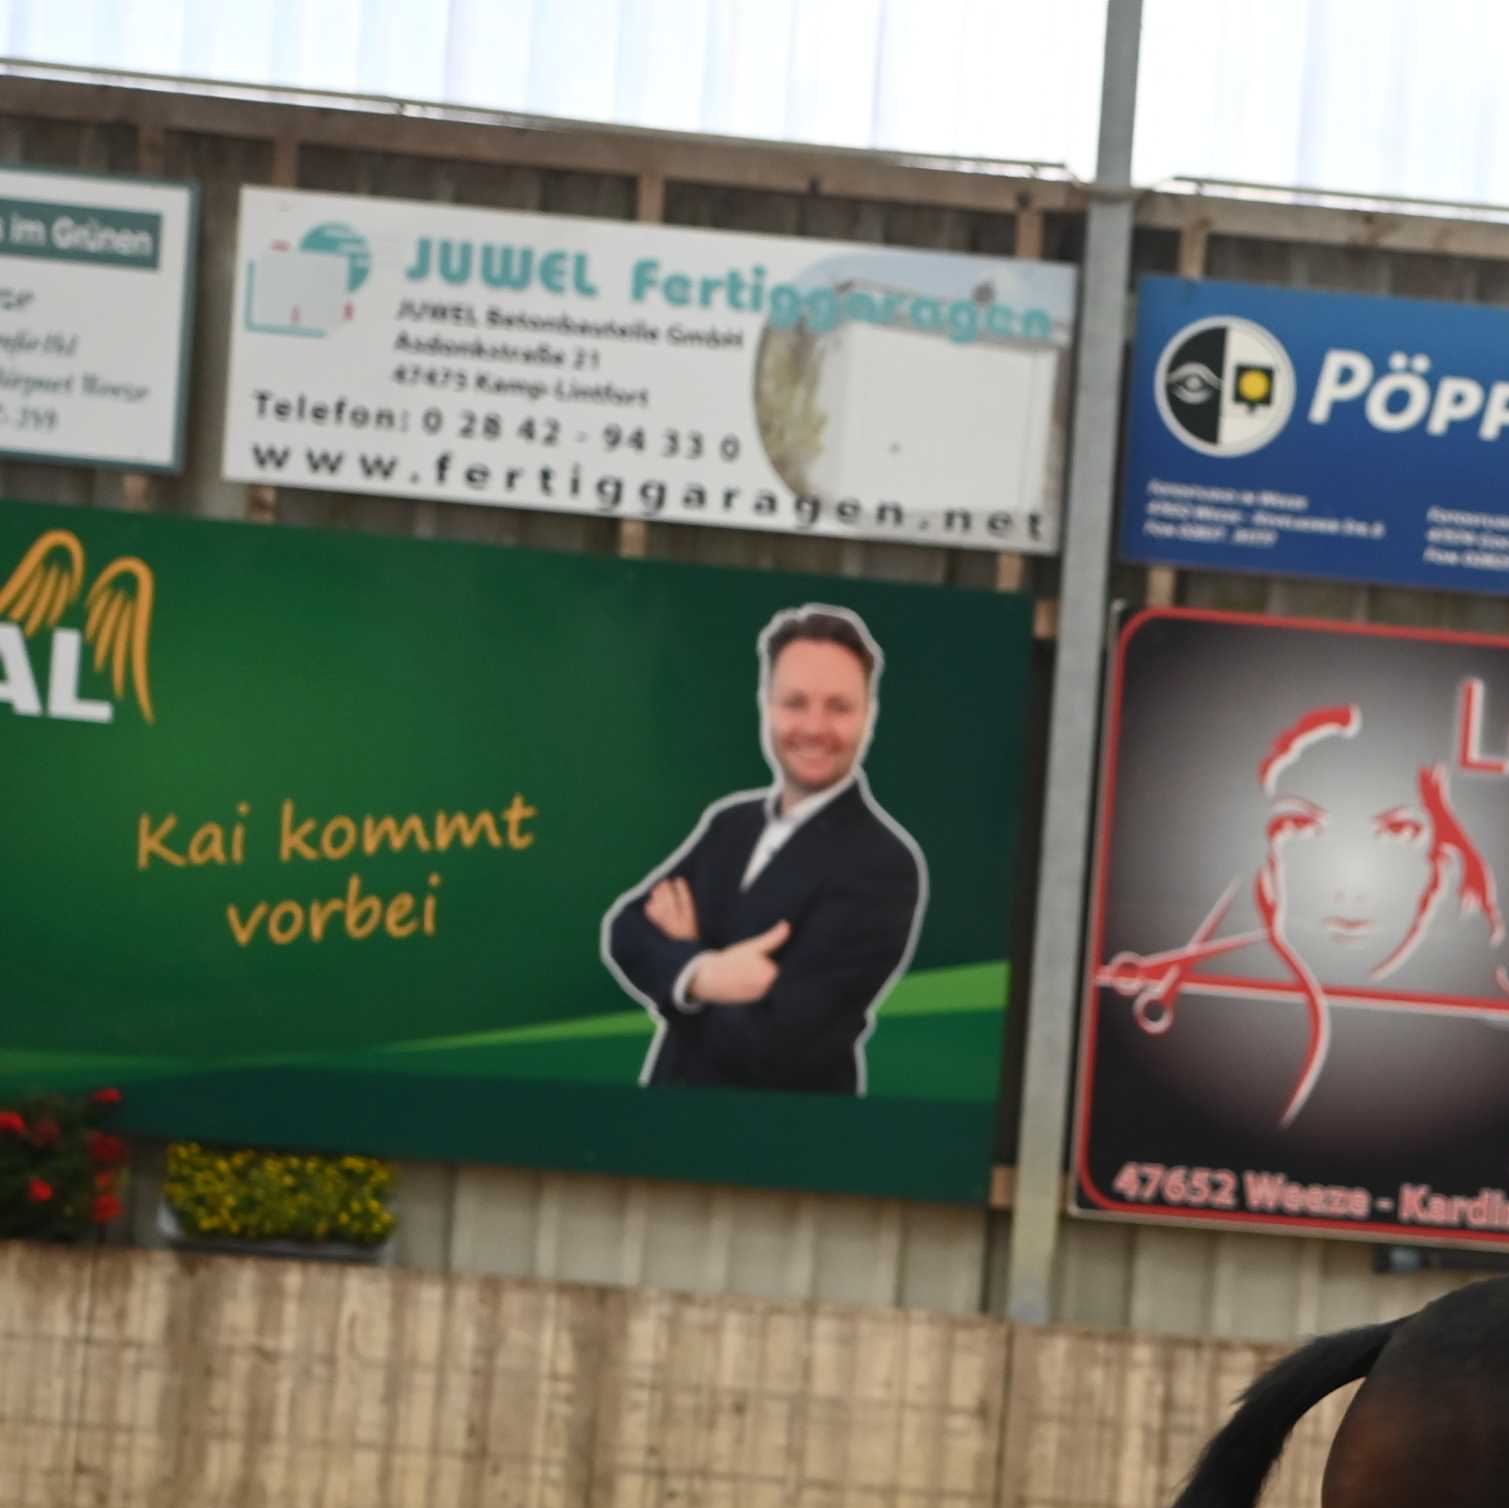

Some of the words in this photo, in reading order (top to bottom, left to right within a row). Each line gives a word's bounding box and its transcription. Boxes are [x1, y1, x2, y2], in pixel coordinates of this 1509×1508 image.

[405, 237, 599, 297] JUWEL
[253, 389, 411, 434] Telefon:
[252, 443, 1044, 542] www.fertiggaragen.net
[138, 802, 251, 870] Kai
[279, 794, 540, 863] kommt
[226, 873, 441, 947] vorbei
[1112, 1160, 1238, 1208] 47652
[1244, 1171, 1371, 1219] Weeze
